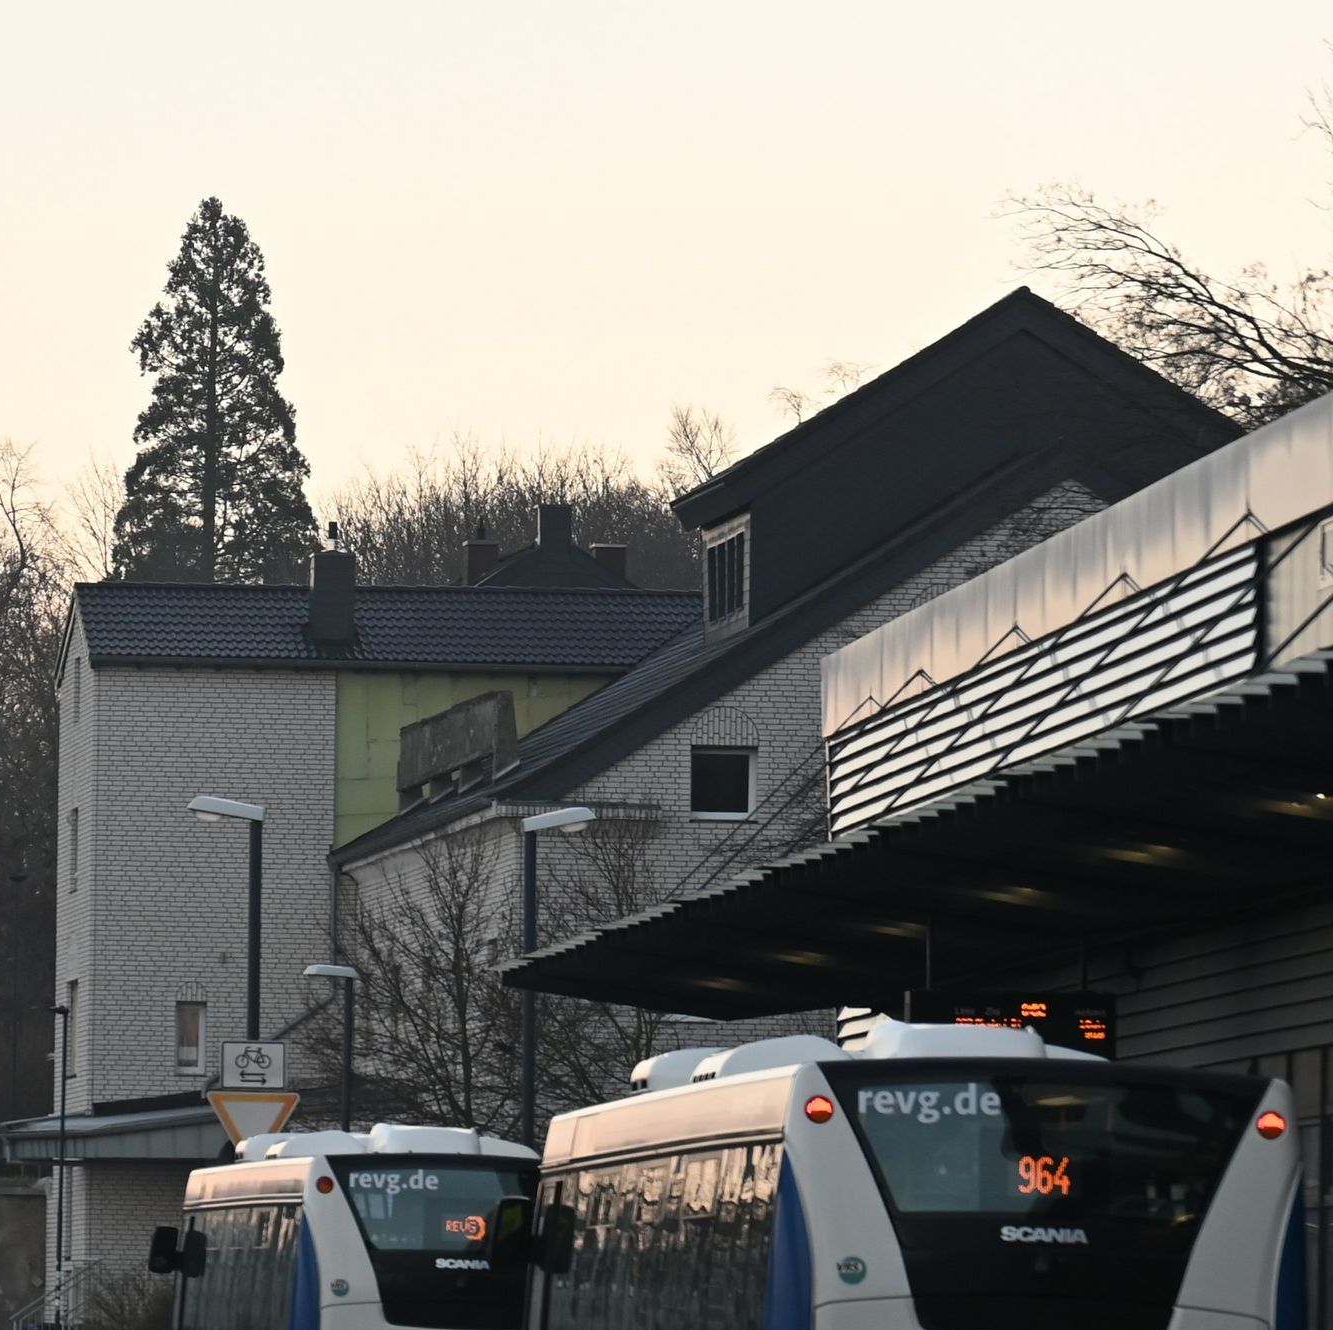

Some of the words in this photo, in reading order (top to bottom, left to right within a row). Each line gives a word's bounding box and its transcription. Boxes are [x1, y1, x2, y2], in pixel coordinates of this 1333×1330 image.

[858, 1083, 1001, 1123] revg.de
[348, 1169, 439, 1194] revg.de
[1018, 1156, 1071, 1195] 964
[1001, 1226, 1089, 1244] SCANIA
[435, 1258, 491, 1270] SCANIA
